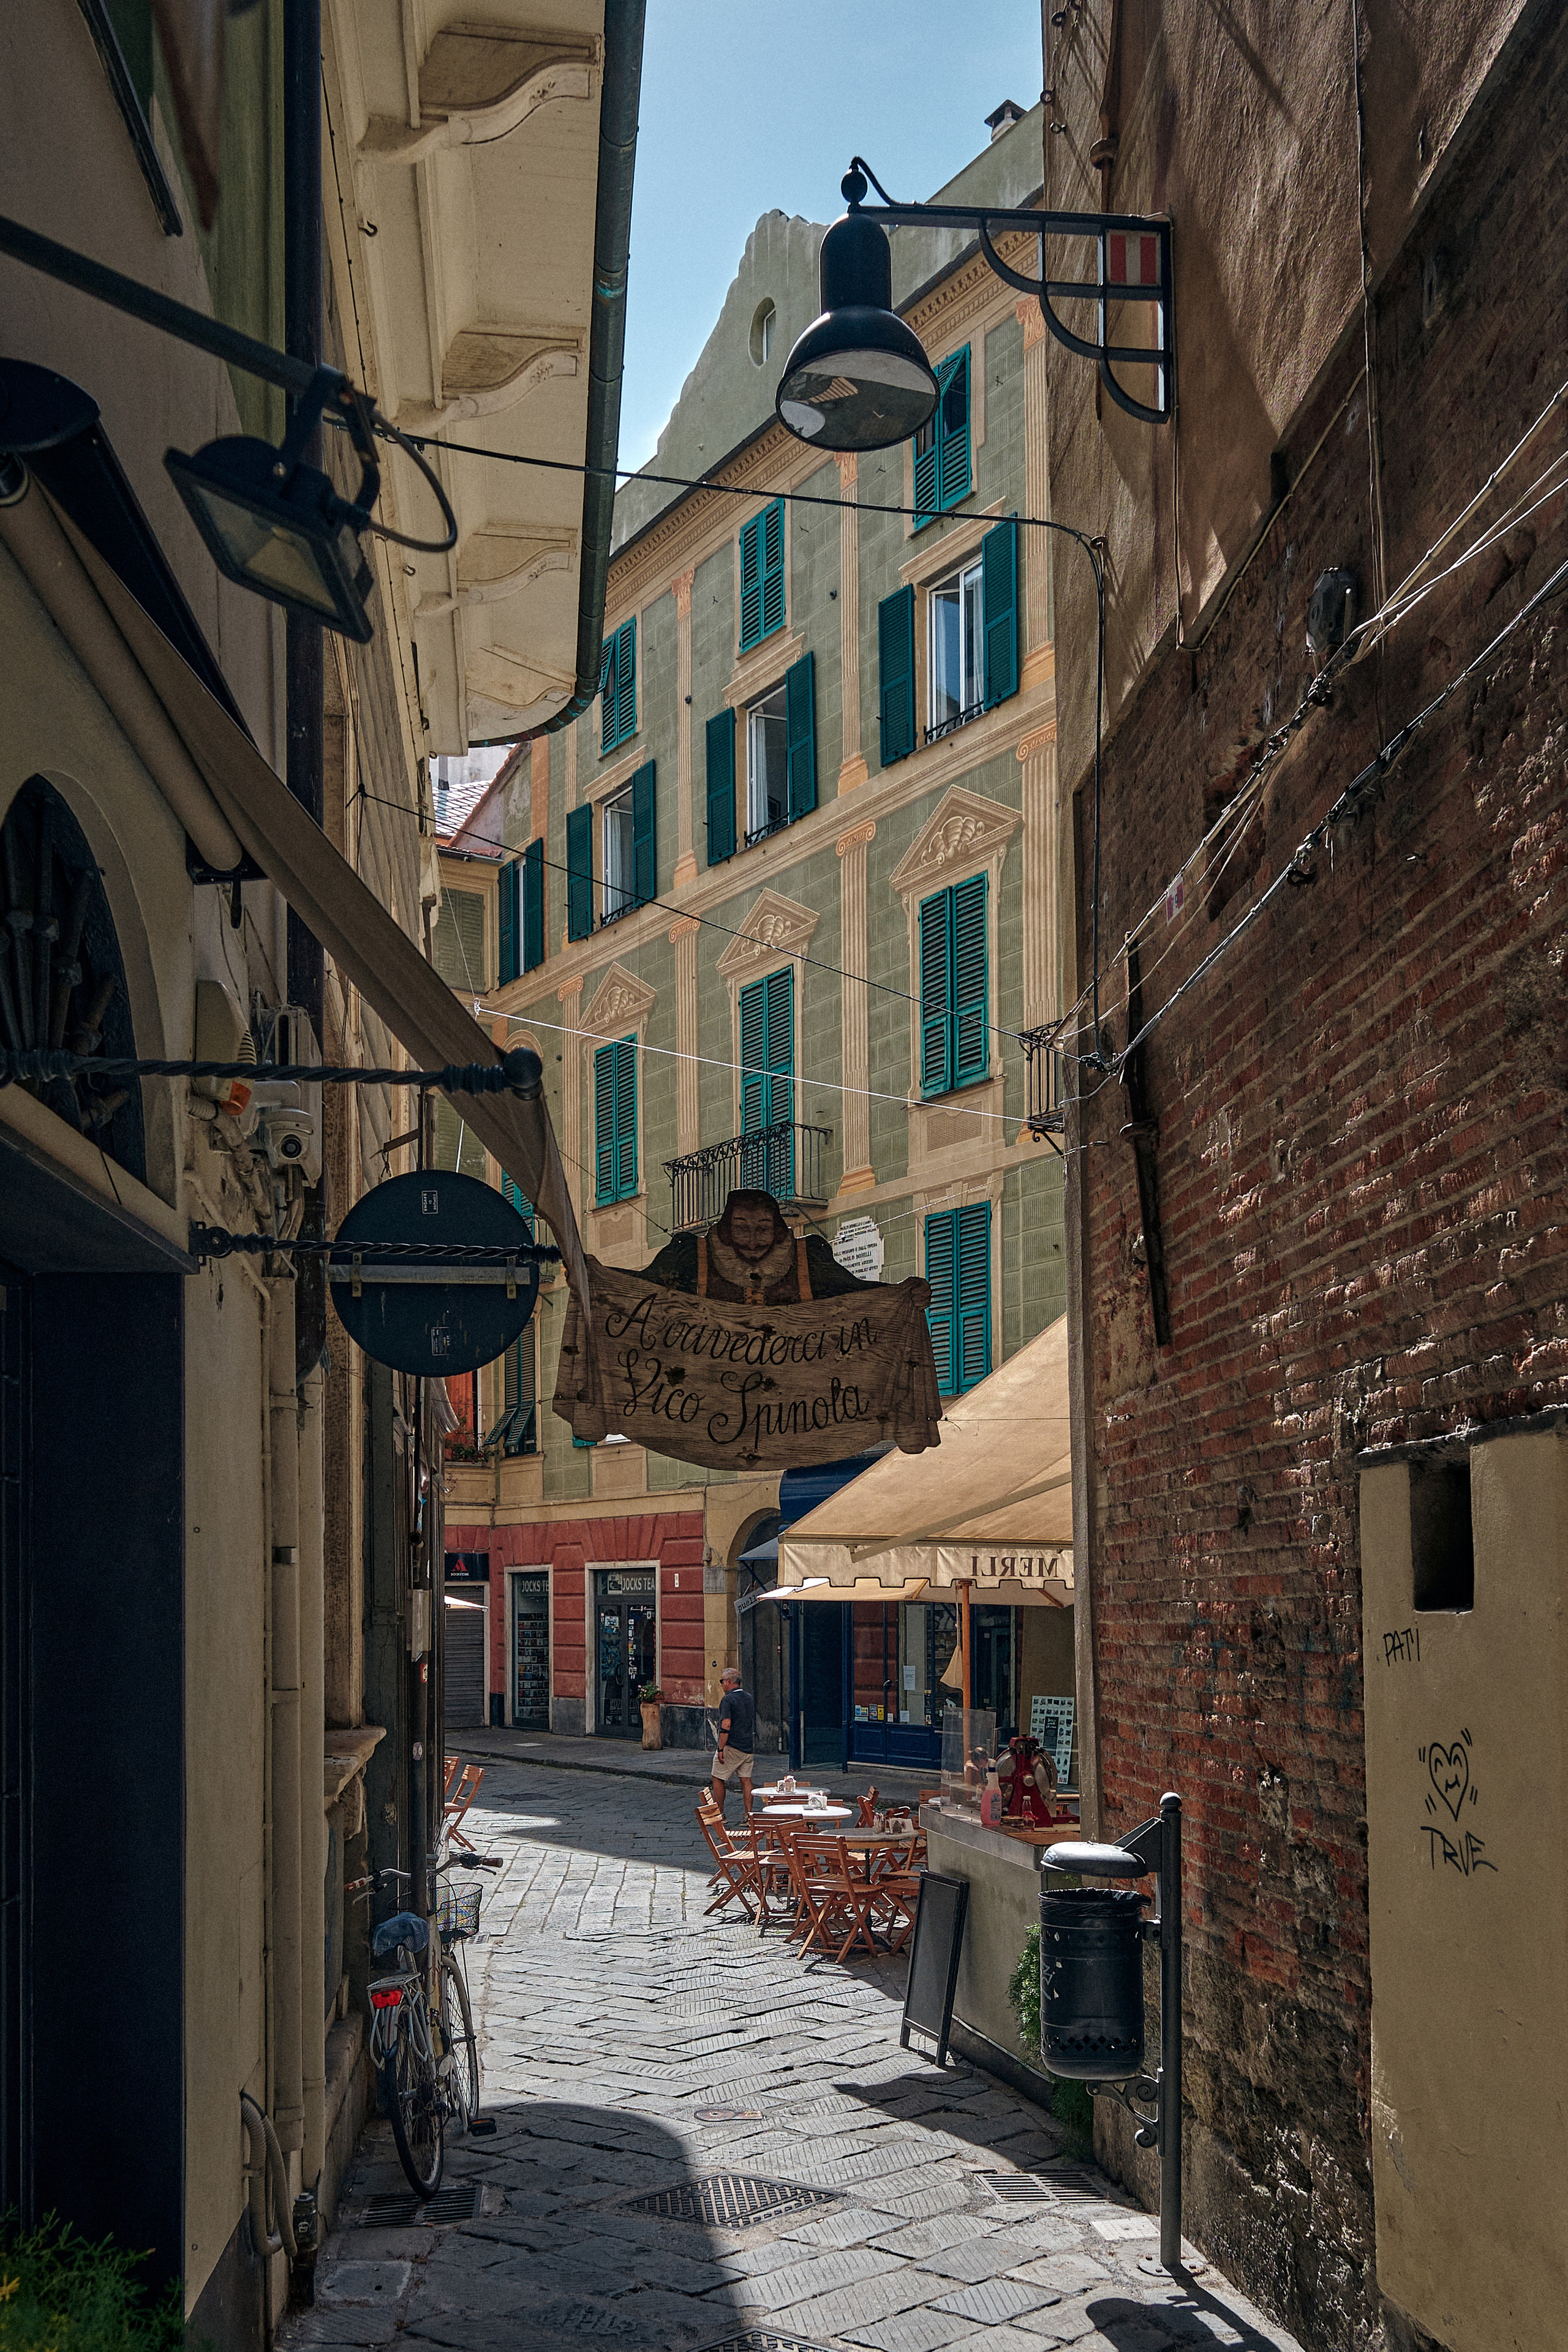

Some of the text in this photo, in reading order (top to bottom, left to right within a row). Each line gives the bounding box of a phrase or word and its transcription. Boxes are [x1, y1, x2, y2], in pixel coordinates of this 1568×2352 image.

[856, 1251, 872, 1259] BOSELLI
[605, 1293, 878, 1365] Arrivederci in
[618, 1348, 870, 1450] Vico Spinola
[522, 1580, 540, 1593] JOCKS
[623, 1577, 641, 1591] JOCKS
